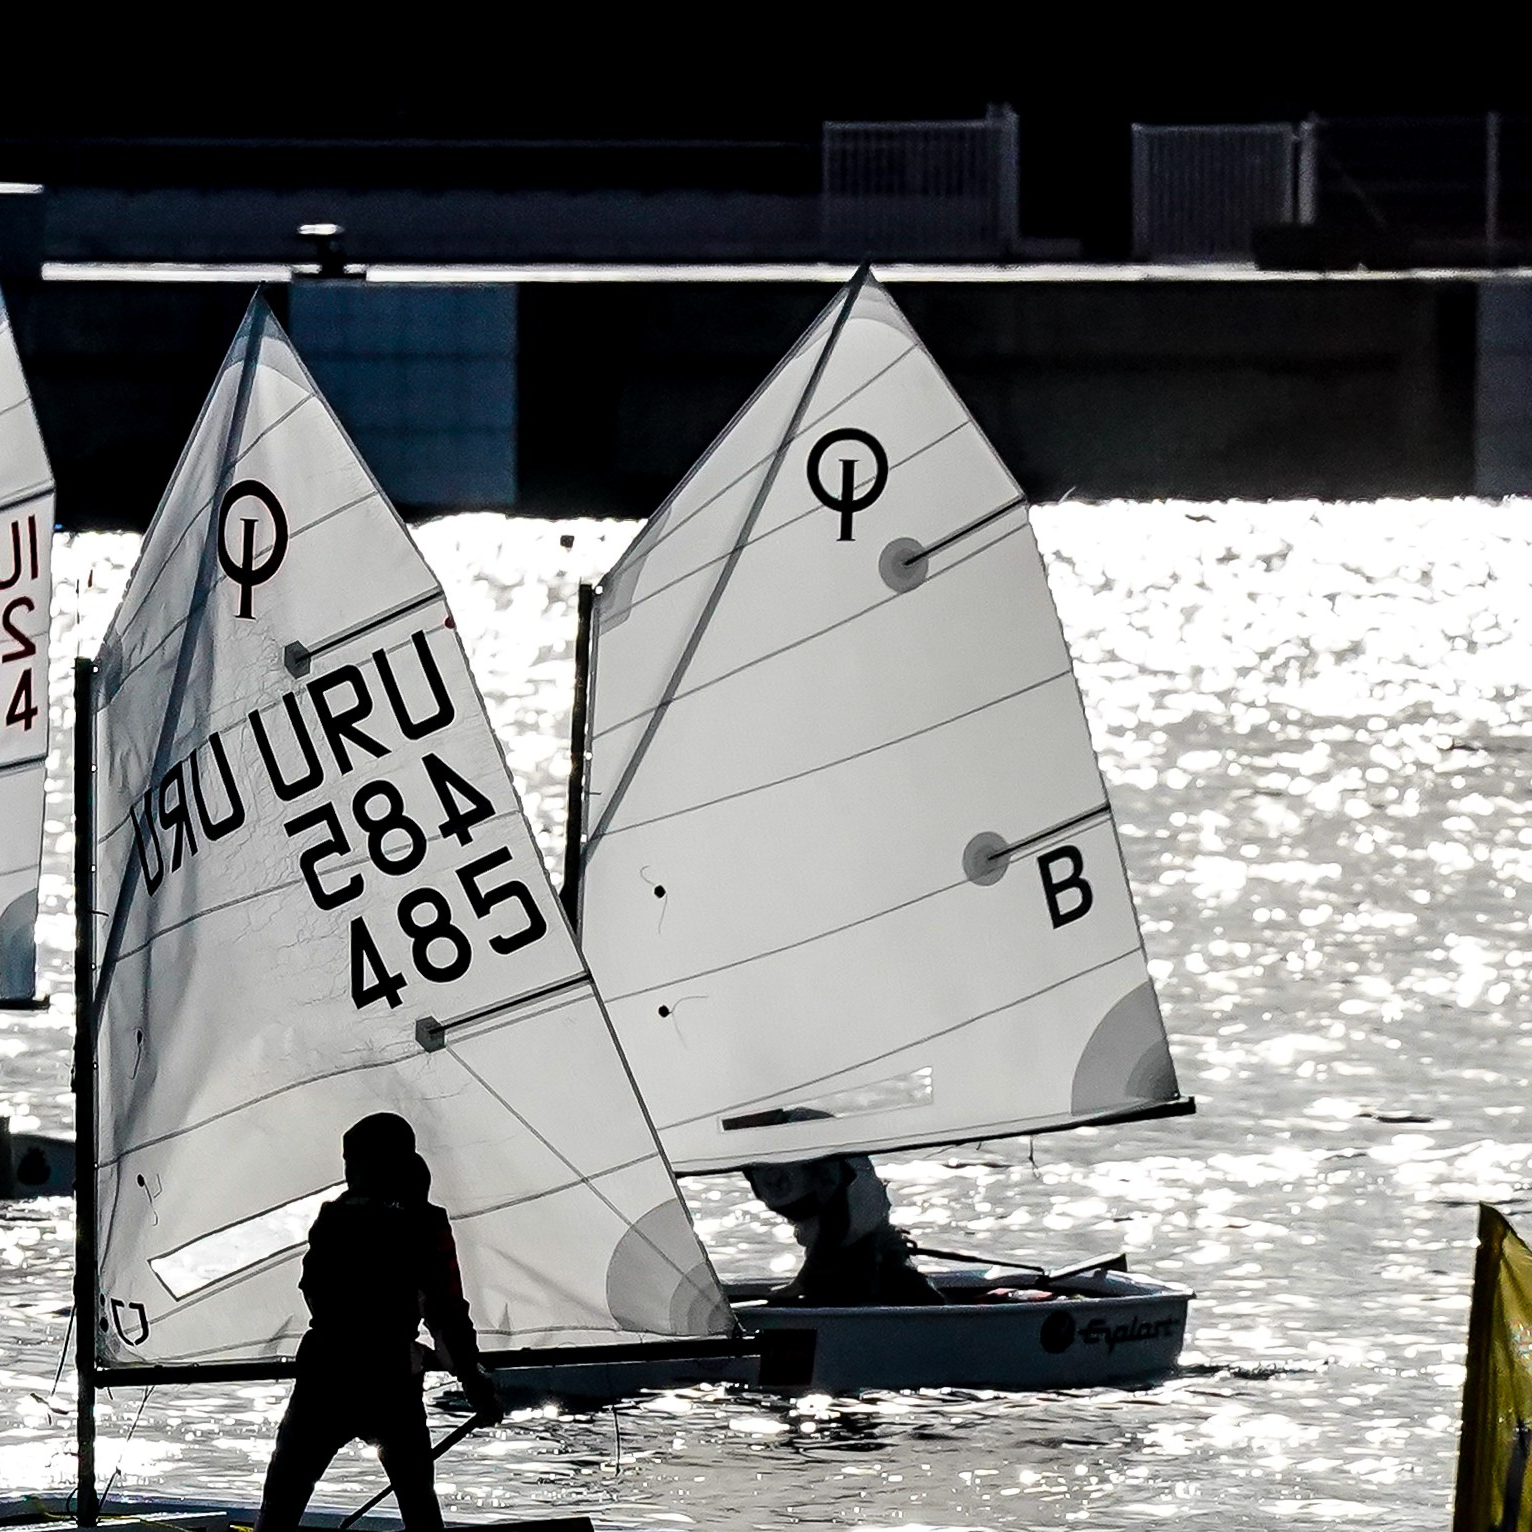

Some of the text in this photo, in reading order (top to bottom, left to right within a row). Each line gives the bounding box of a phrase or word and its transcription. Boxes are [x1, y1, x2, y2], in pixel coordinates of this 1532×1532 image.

[247, 628, 457, 802] URU
[350, 845, 548, 1011] 485
[1036, 843, 1095, 930] B
